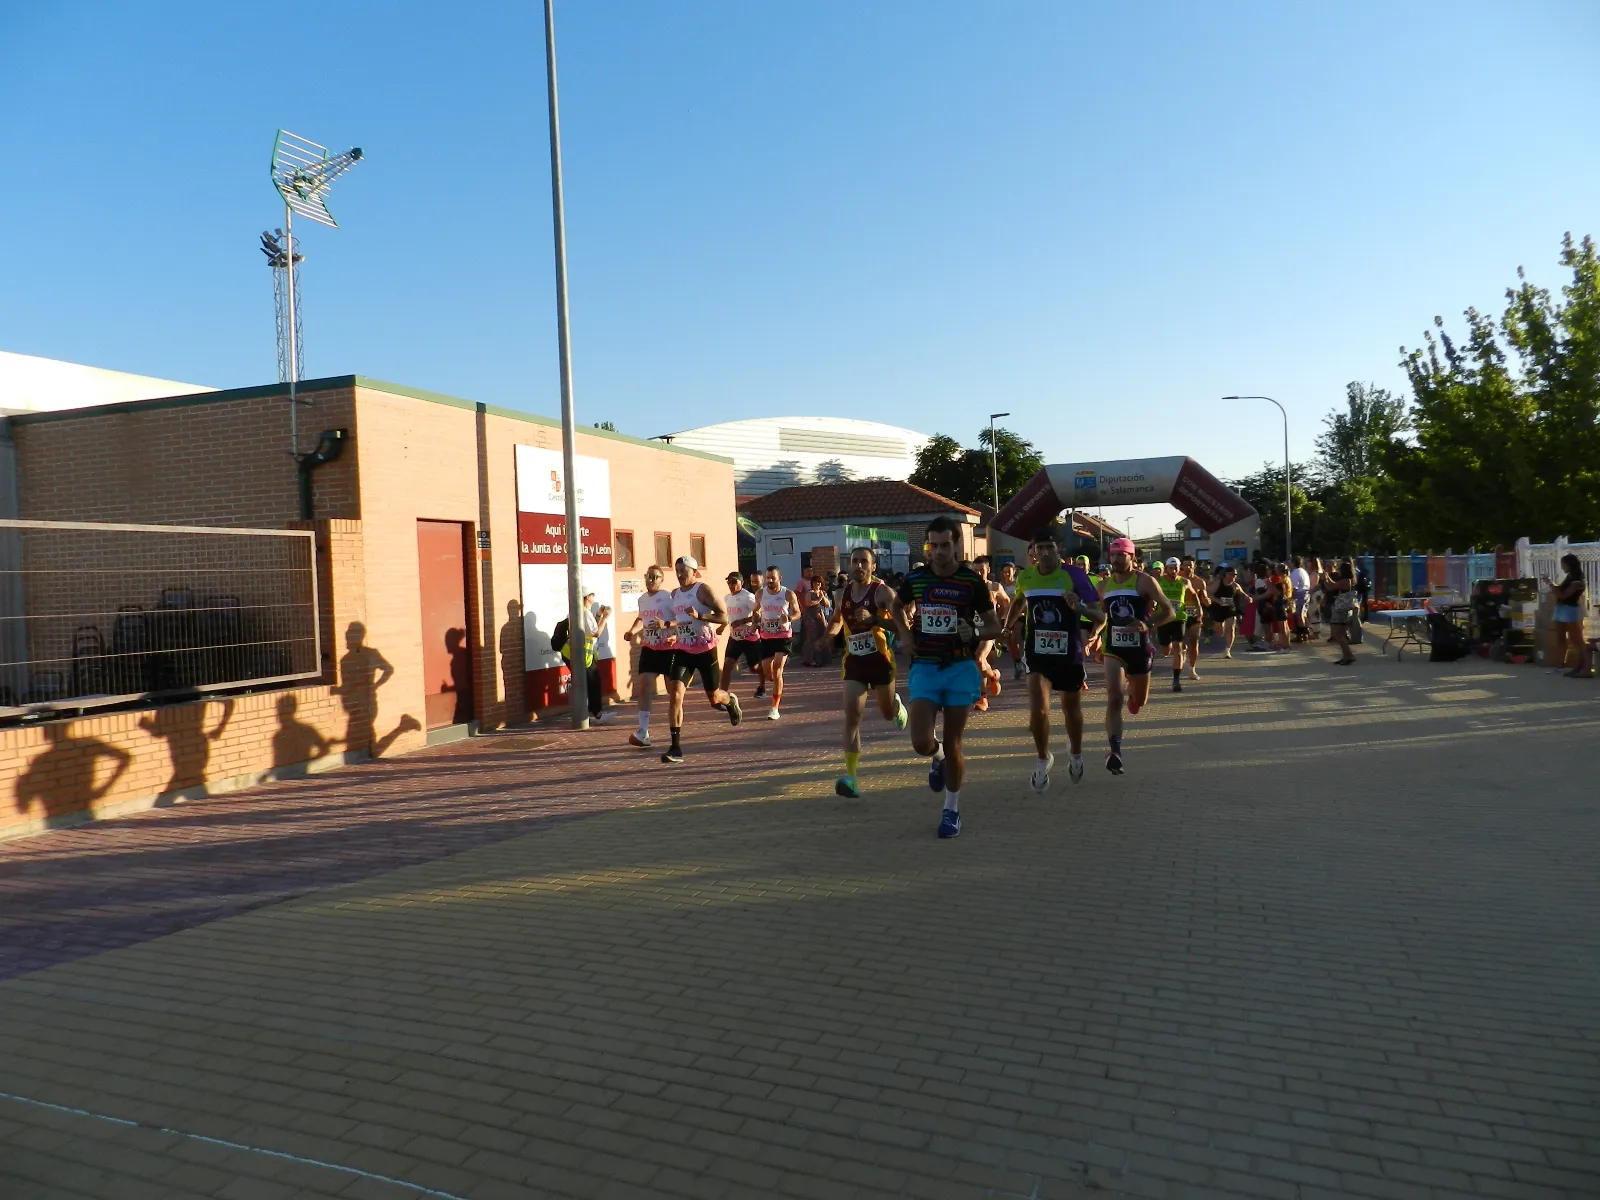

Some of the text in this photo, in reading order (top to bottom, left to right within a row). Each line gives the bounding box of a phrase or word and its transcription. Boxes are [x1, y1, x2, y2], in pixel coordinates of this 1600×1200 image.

[1099, 473, 1145, 485] Diputación
[1110, 485, 1154, 496] Salamanca
[545, 523, 561, 537] Aquí
[521, 541, 529, 554] la
[530, 541, 551, 554] Junta
[552, 542, 562, 554] de
[589, 545, 595, 557] y
[595, 543, 612, 555] León
[927, 615, 951, 628] 369
[645, 629, 659, 637] 374
[1115, 632, 1135, 642] 308
[852, 640, 871, 652] 366
[1039, 637, 1061, 649] 341
